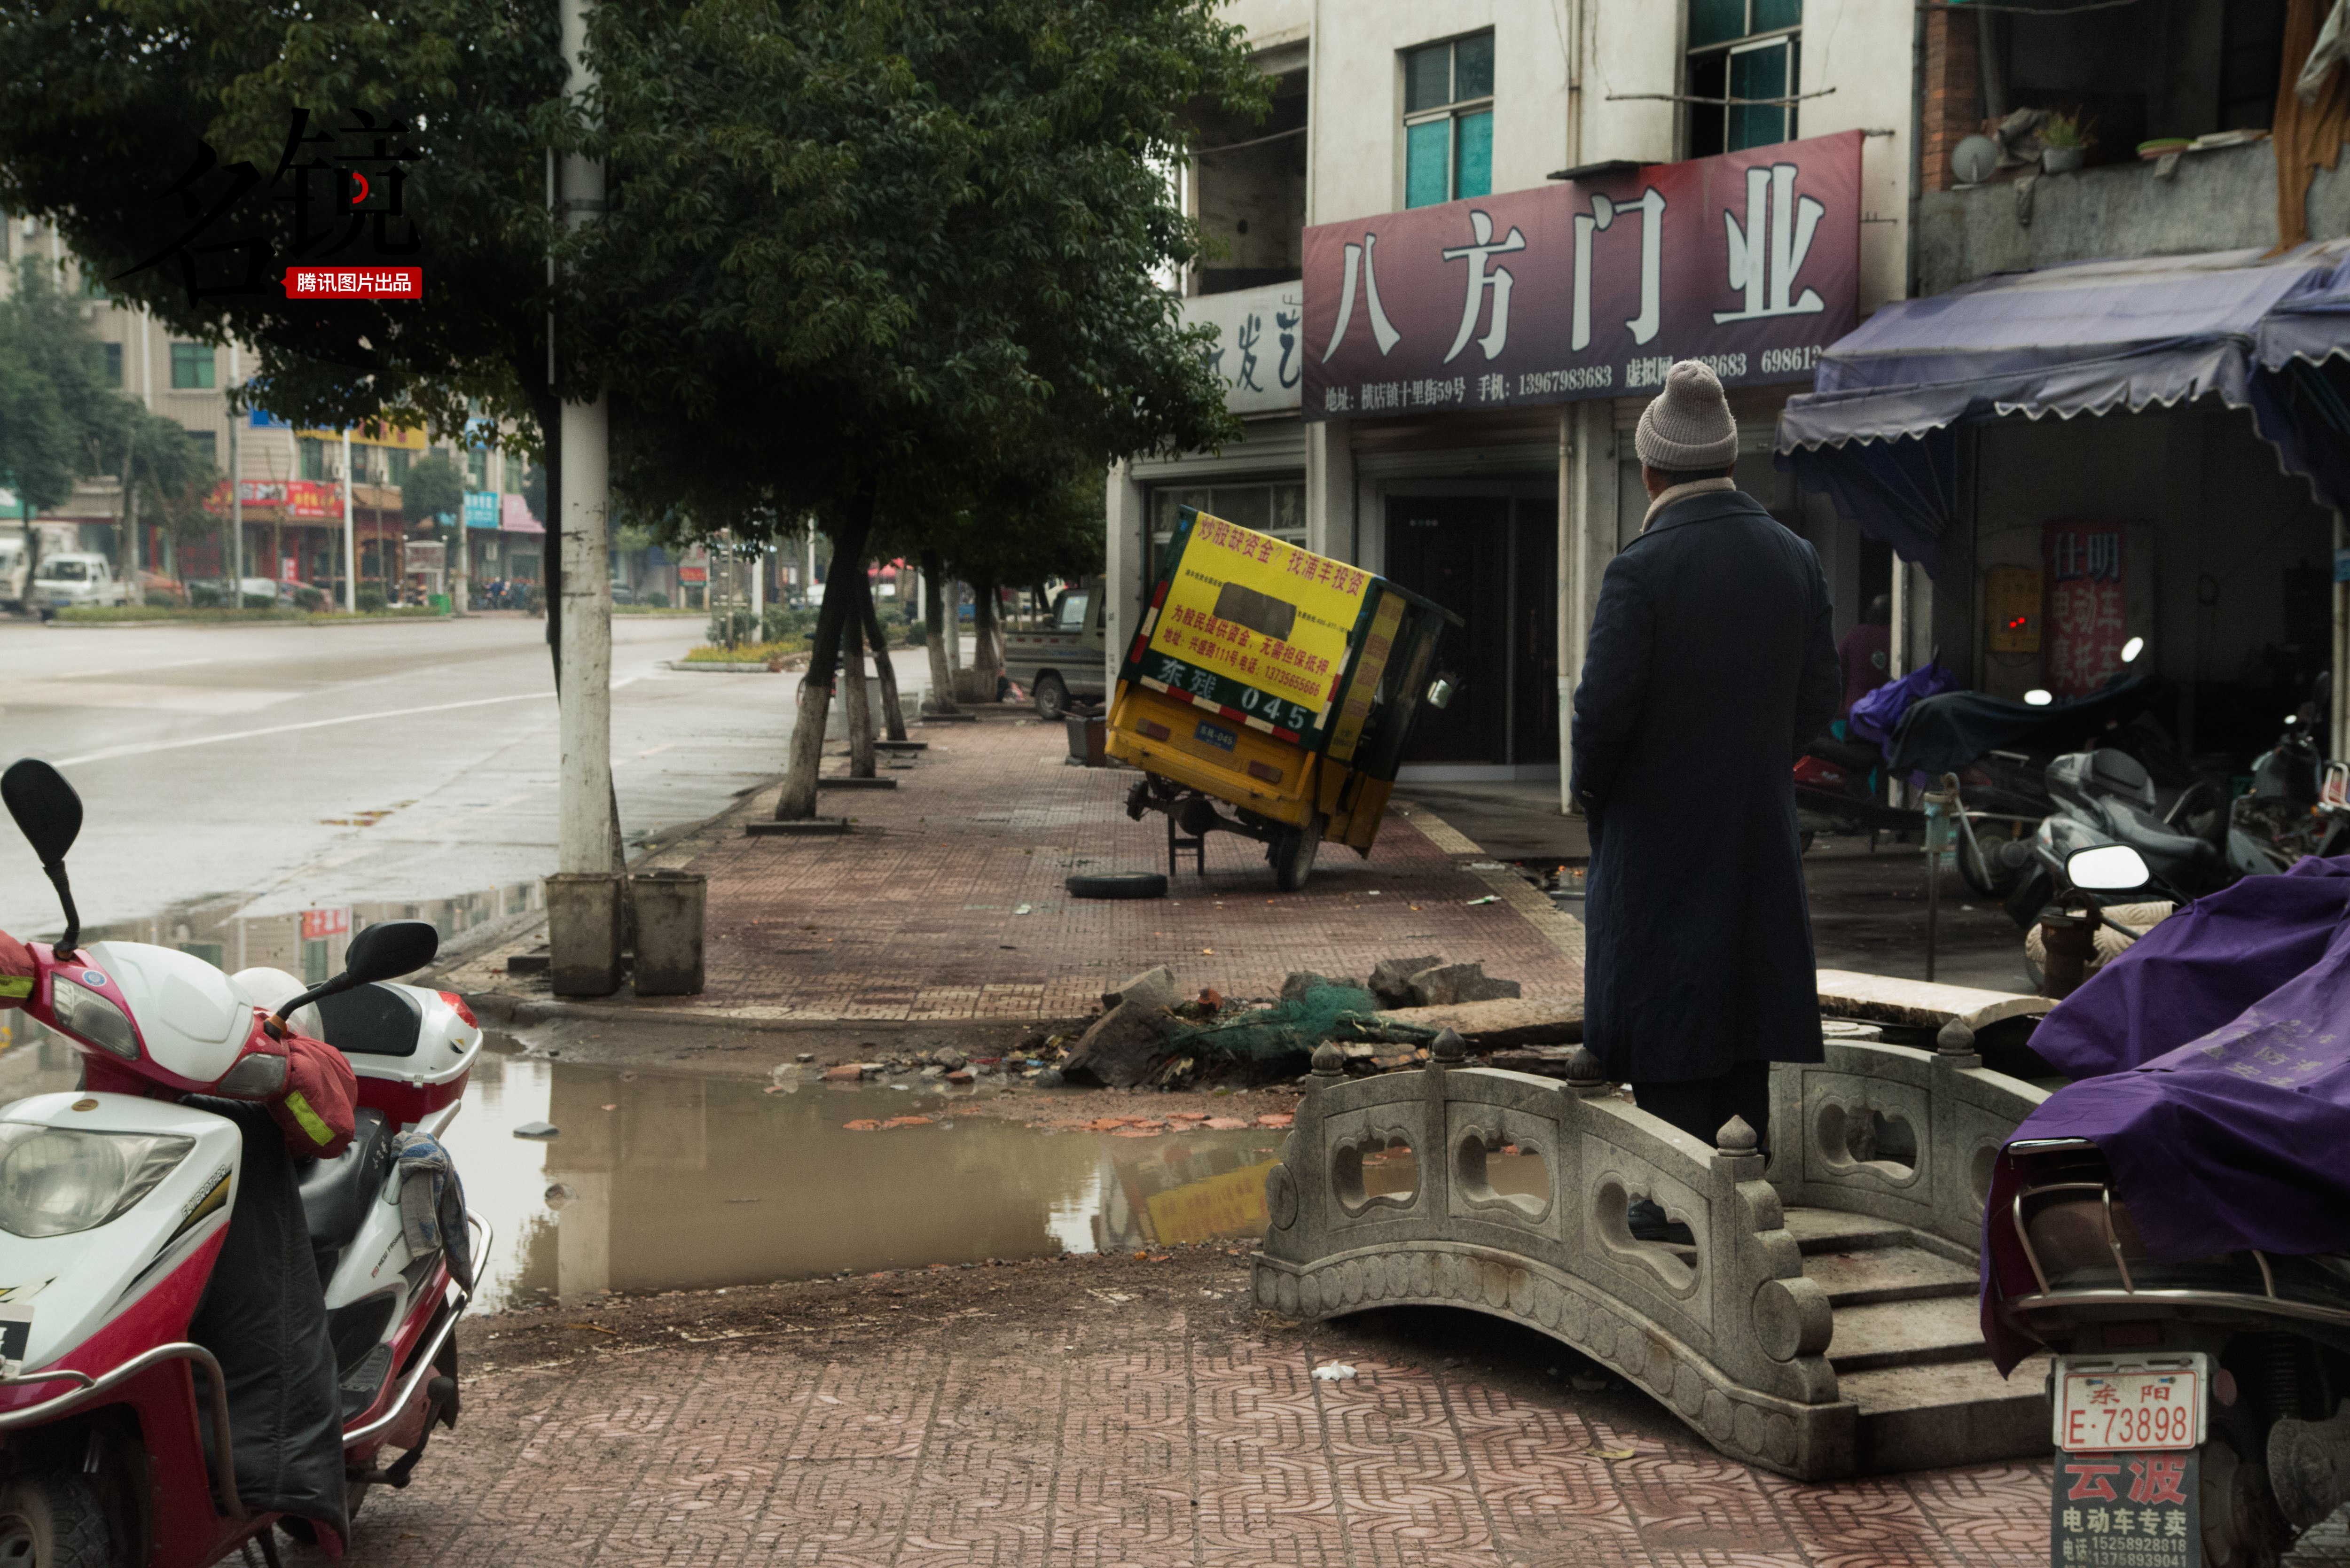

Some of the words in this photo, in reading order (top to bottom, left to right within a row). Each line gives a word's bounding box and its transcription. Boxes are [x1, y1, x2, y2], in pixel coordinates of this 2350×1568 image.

[1321, 162, 1825, 365] 八方门业
[1241, 686, 1308, 729] 045
[2090, 1384, 2171, 1405] 东阳
[2065, 1453, 2187, 1506] 云波
[2063, 1506, 2187, 1537] 电动车专卖
